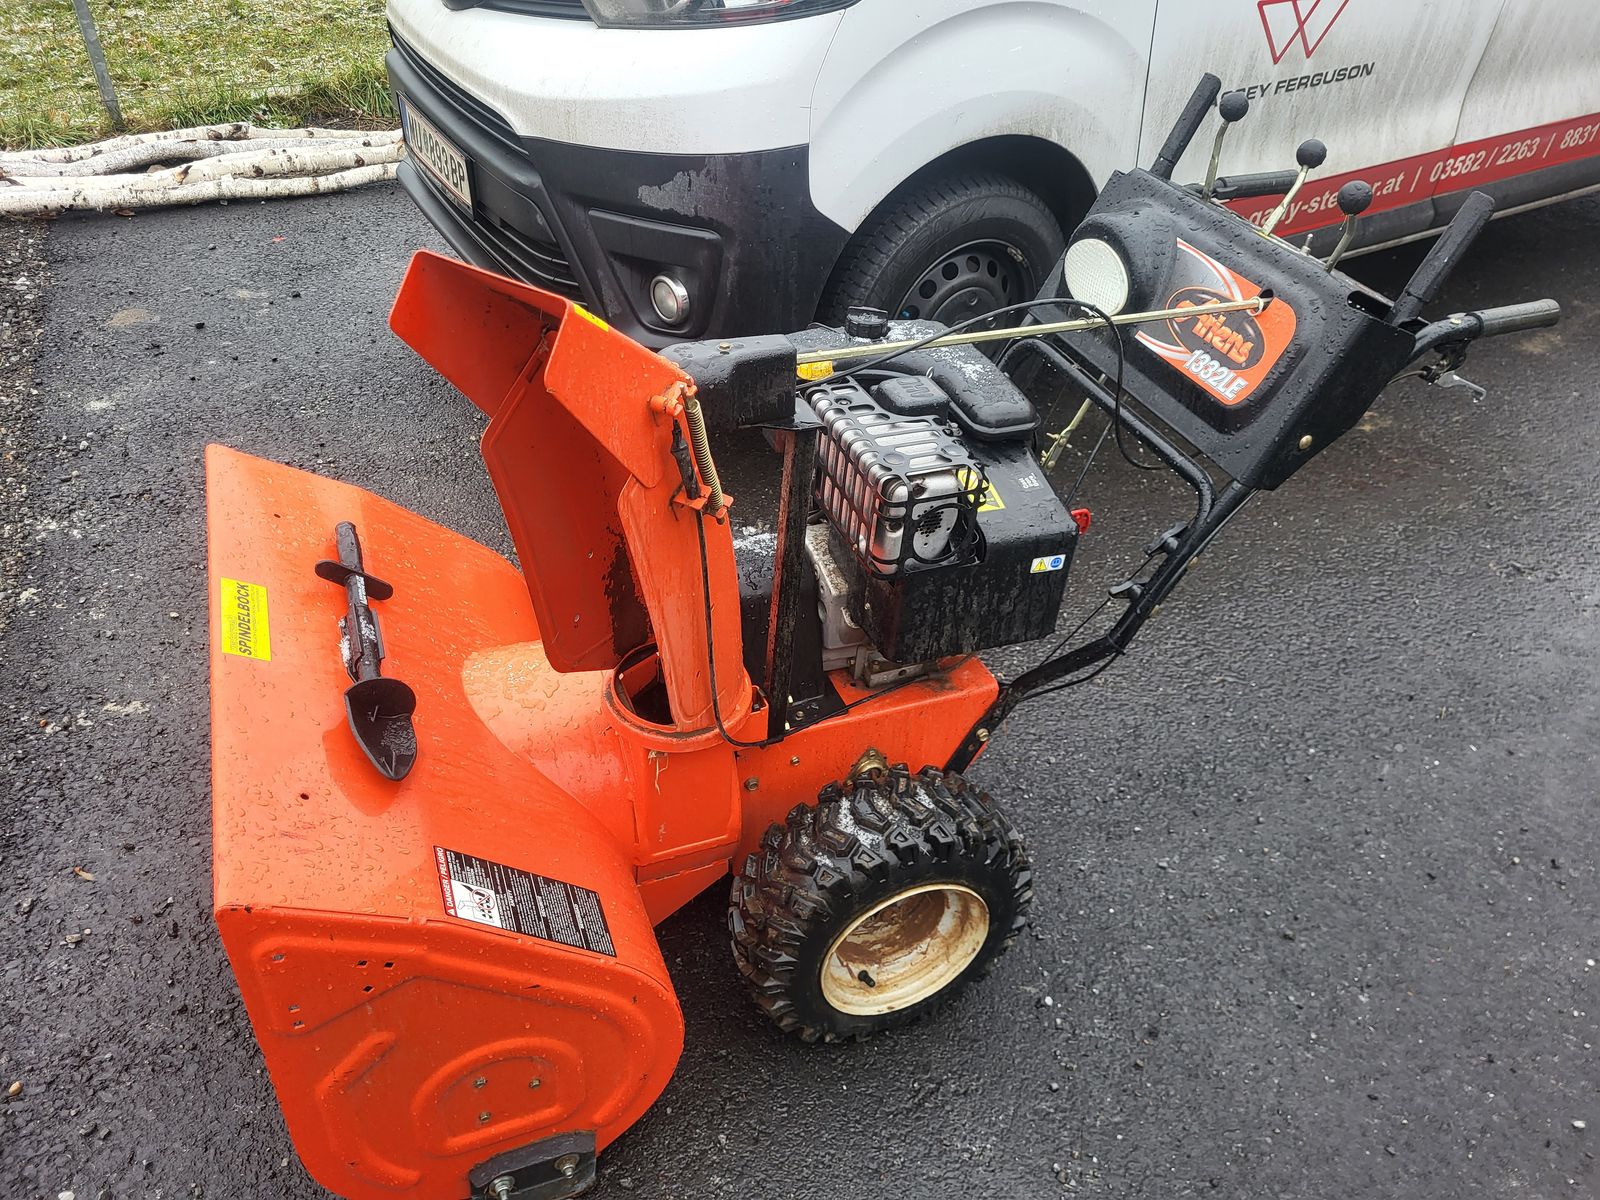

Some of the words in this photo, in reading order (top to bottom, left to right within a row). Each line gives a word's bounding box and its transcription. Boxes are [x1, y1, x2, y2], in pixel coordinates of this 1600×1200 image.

[1274, 62, 1375, 95] FERGUSON
[1183, 349, 1249, 401] 1332LE
[442, 879, 454, 907] DANGER
